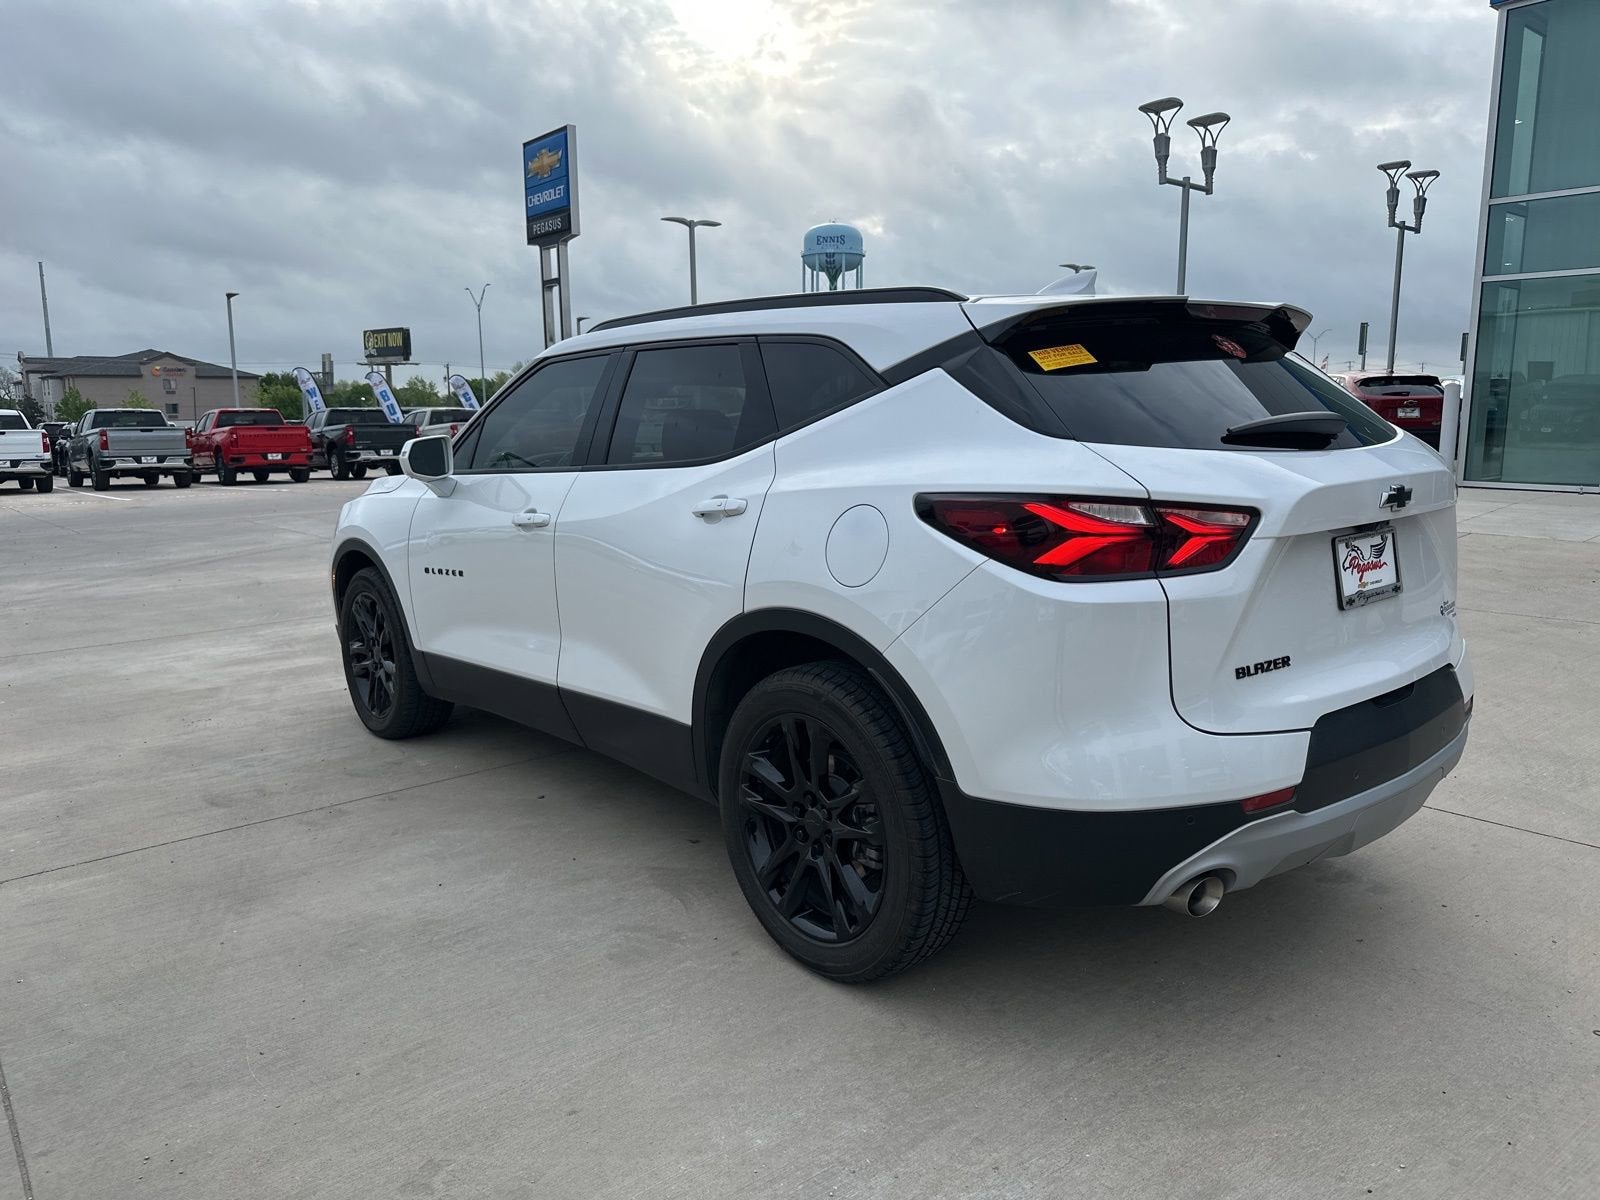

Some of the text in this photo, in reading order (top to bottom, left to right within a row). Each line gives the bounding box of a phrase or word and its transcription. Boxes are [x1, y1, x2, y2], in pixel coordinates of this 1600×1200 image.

[527, 185, 565, 207] CHEVROLET
[533, 218, 562, 235] PEGASUS
[816, 234, 846, 246] ENNIS
[373, 331, 403, 348] EXIT NOW
[424, 567, 465, 578] BLAZER
[1235, 655, 1291, 680] BLAZER
